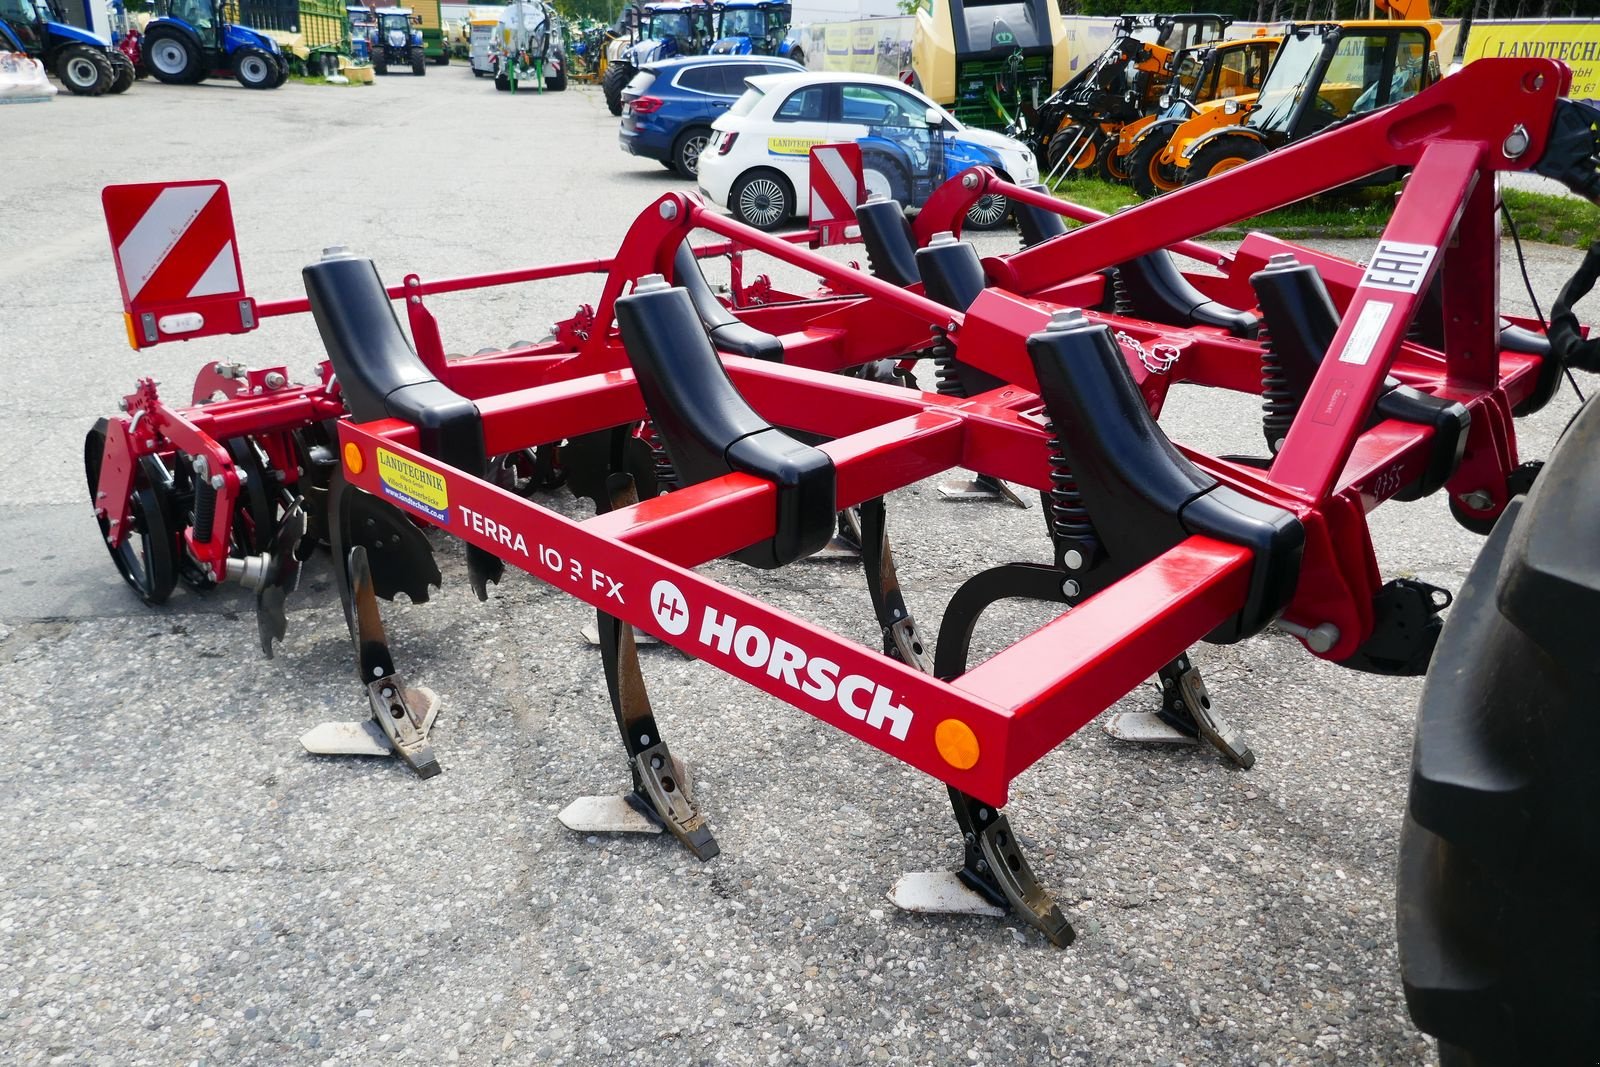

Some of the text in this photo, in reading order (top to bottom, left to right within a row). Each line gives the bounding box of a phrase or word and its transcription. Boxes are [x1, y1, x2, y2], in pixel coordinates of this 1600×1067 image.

[1583, 83, 1597, 93] 63
[379, 452, 443, 492] LANDTECHNIK
[384, 487, 445, 521] www.landtechnik.co.at
[387, 477, 404, 489] Villach
[408, 486, 440, 507] Lieserbrücke
[591, 568, 625, 604] FX
[698, 605, 914, 742] HORSCH
